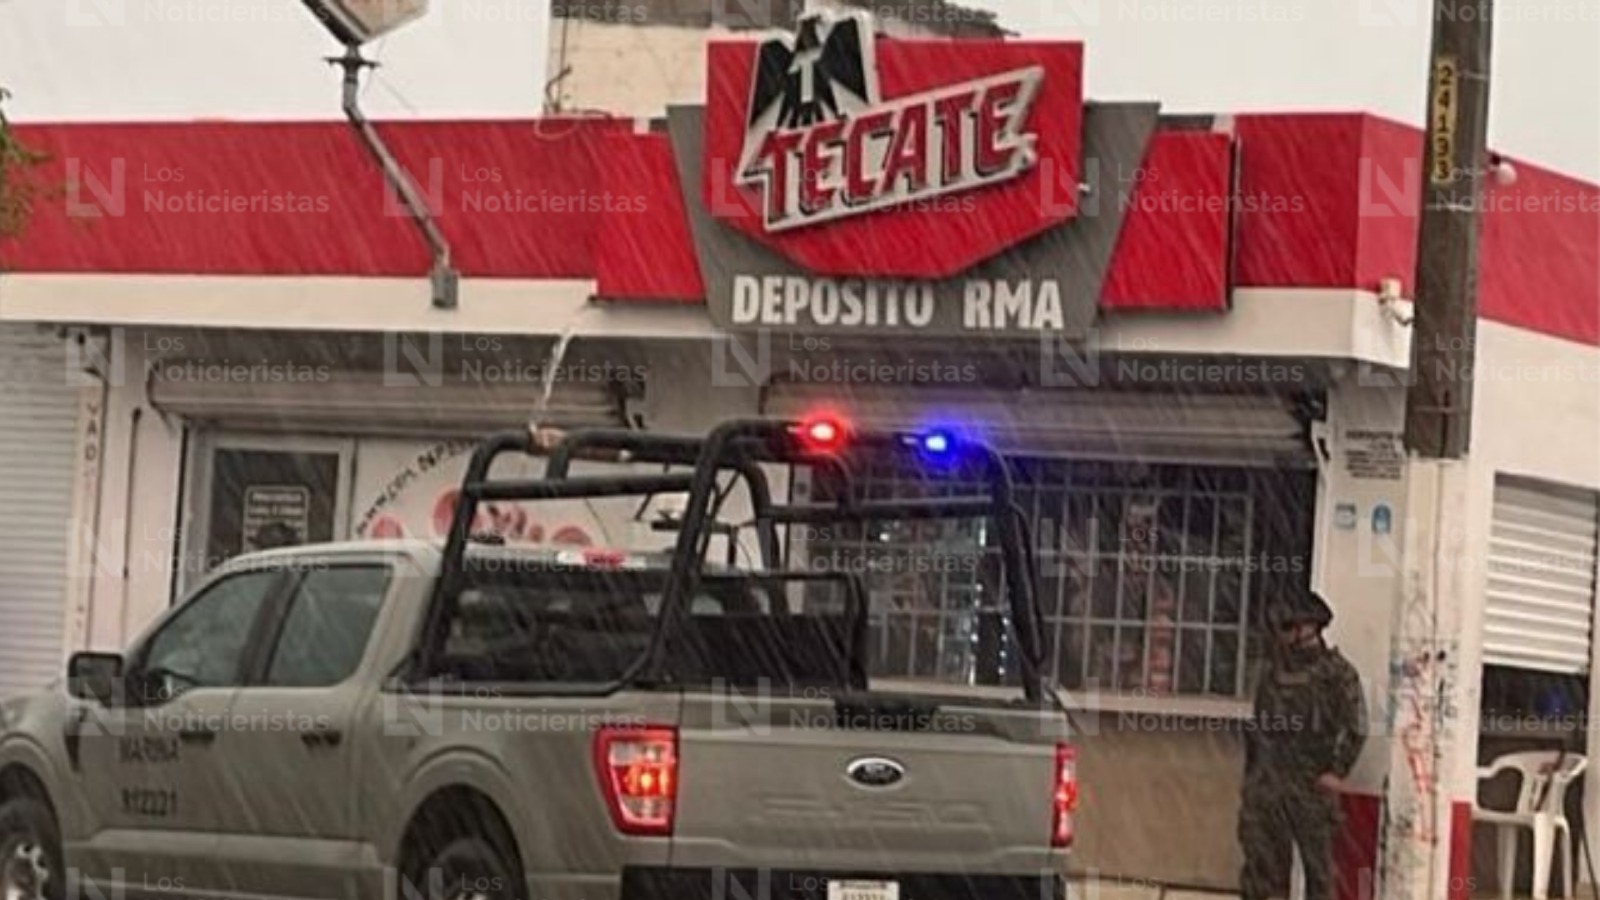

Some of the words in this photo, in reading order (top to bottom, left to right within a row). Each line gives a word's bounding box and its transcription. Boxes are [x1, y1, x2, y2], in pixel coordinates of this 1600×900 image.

[744, 80, 1022, 222] TECATE
[1438, 65, 1451, 180] 24133
[732, 275, 934, 326] DEPOSITO
[962, 279, 1065, 328] RMA
